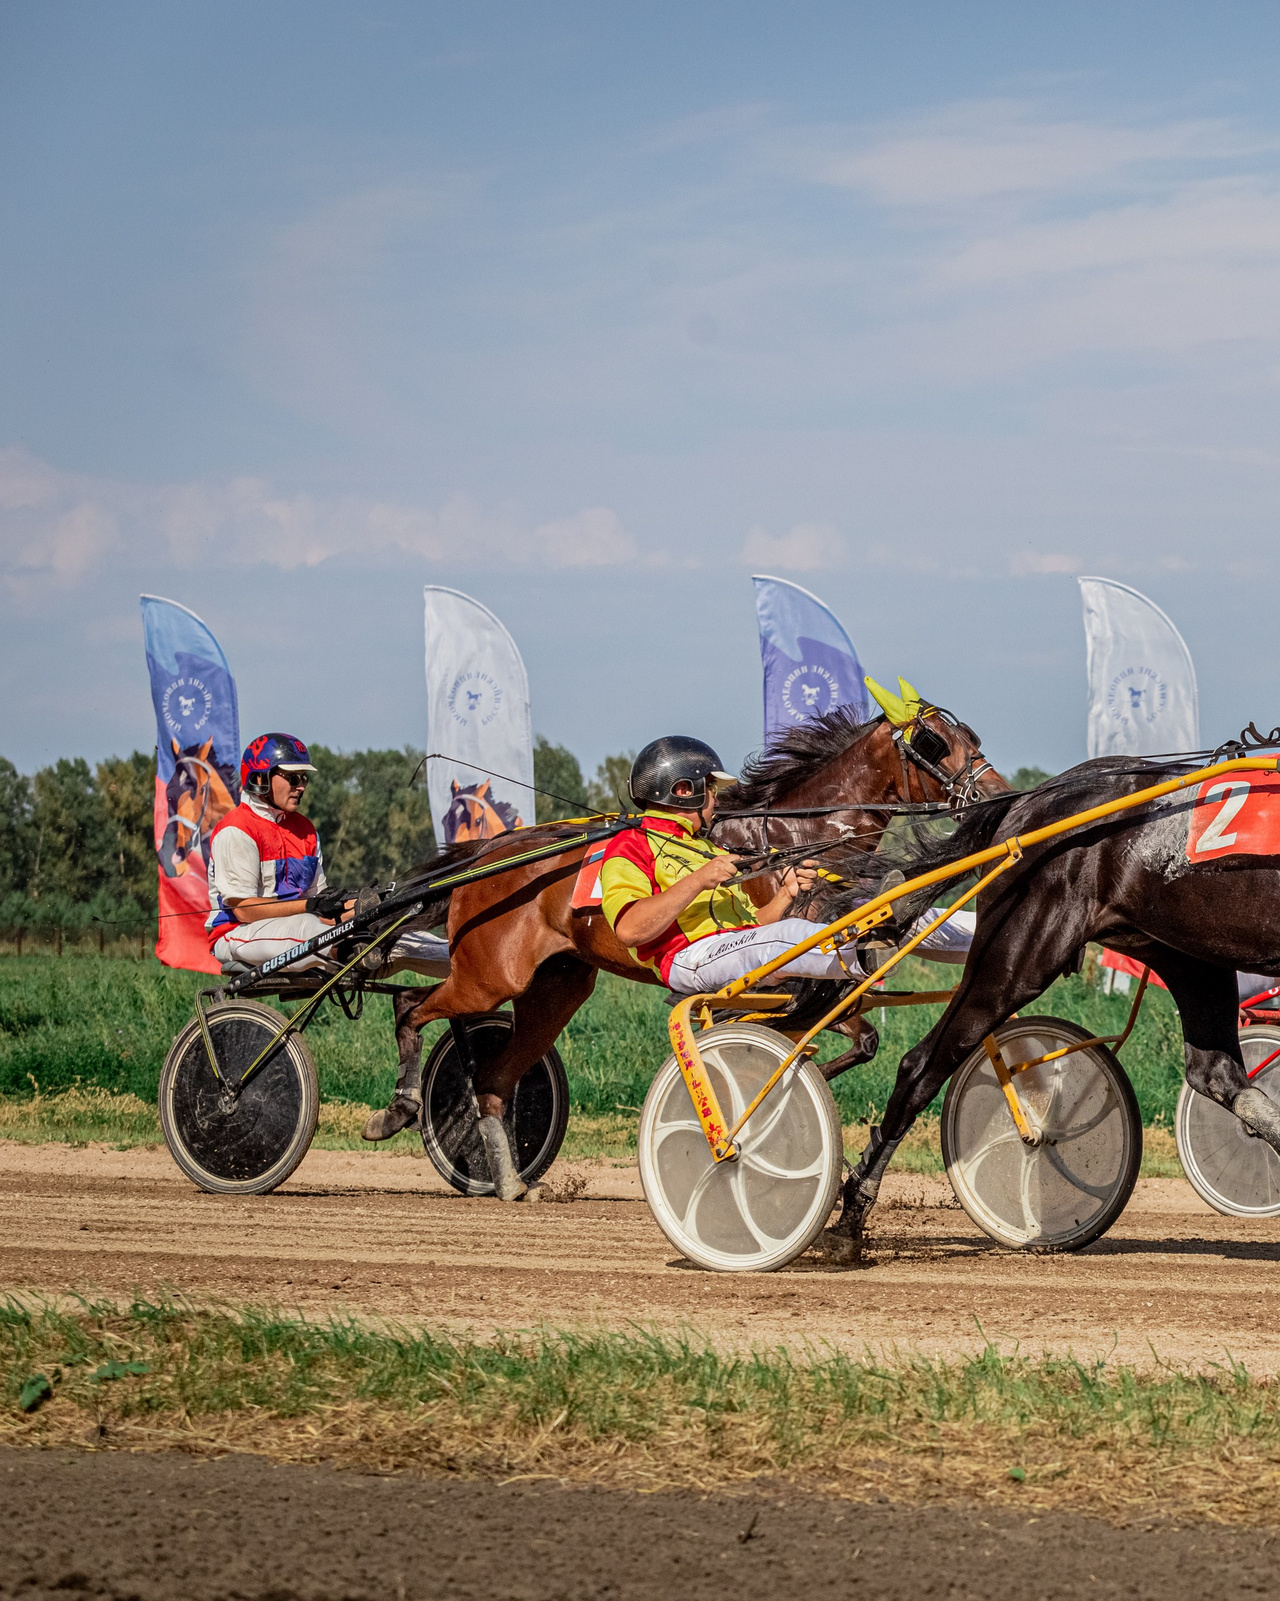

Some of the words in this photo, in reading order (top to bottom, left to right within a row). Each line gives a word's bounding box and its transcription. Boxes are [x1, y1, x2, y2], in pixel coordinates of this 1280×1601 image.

[1195, 780, 1251, 854] 2
[262, 942, 310, 973] CUSTOM
[318, 920, 354, 945] MULTIFLEX
